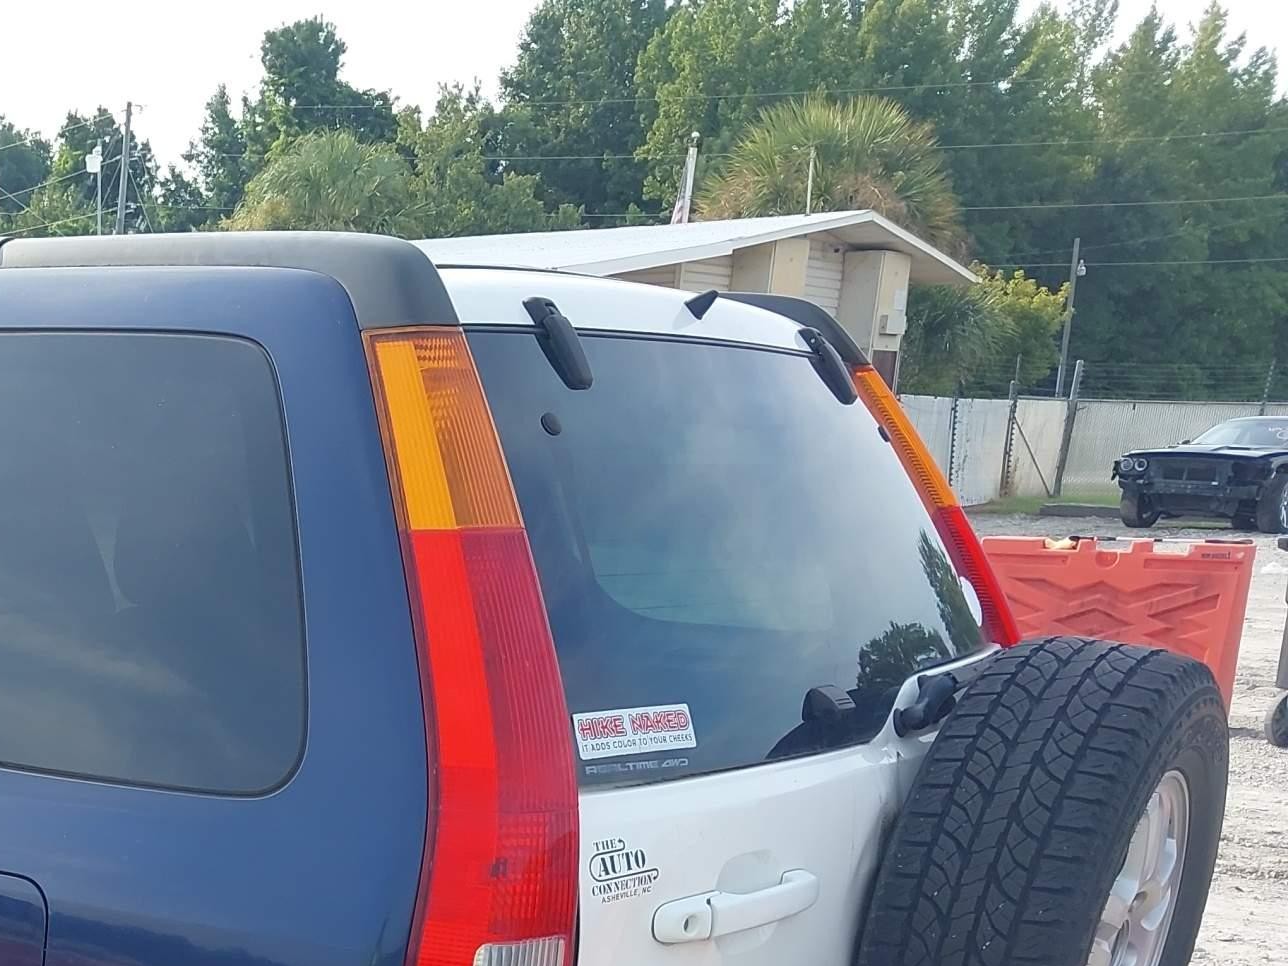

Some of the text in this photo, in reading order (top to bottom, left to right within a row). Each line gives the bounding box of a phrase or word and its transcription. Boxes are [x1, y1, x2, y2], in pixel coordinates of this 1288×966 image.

[578, 709, 690, 741] HIKE NAKED
[582, 733, 693, 753] IT ADDS COLOR TO YOUR CHEEKS
[593, 838, 617, 851] THE
[598, 849, 646, 877] AUTO
[592, 873, 653, 896] CONNECTION
[601, 886, 652, 904] ASHEVILLE, NC
